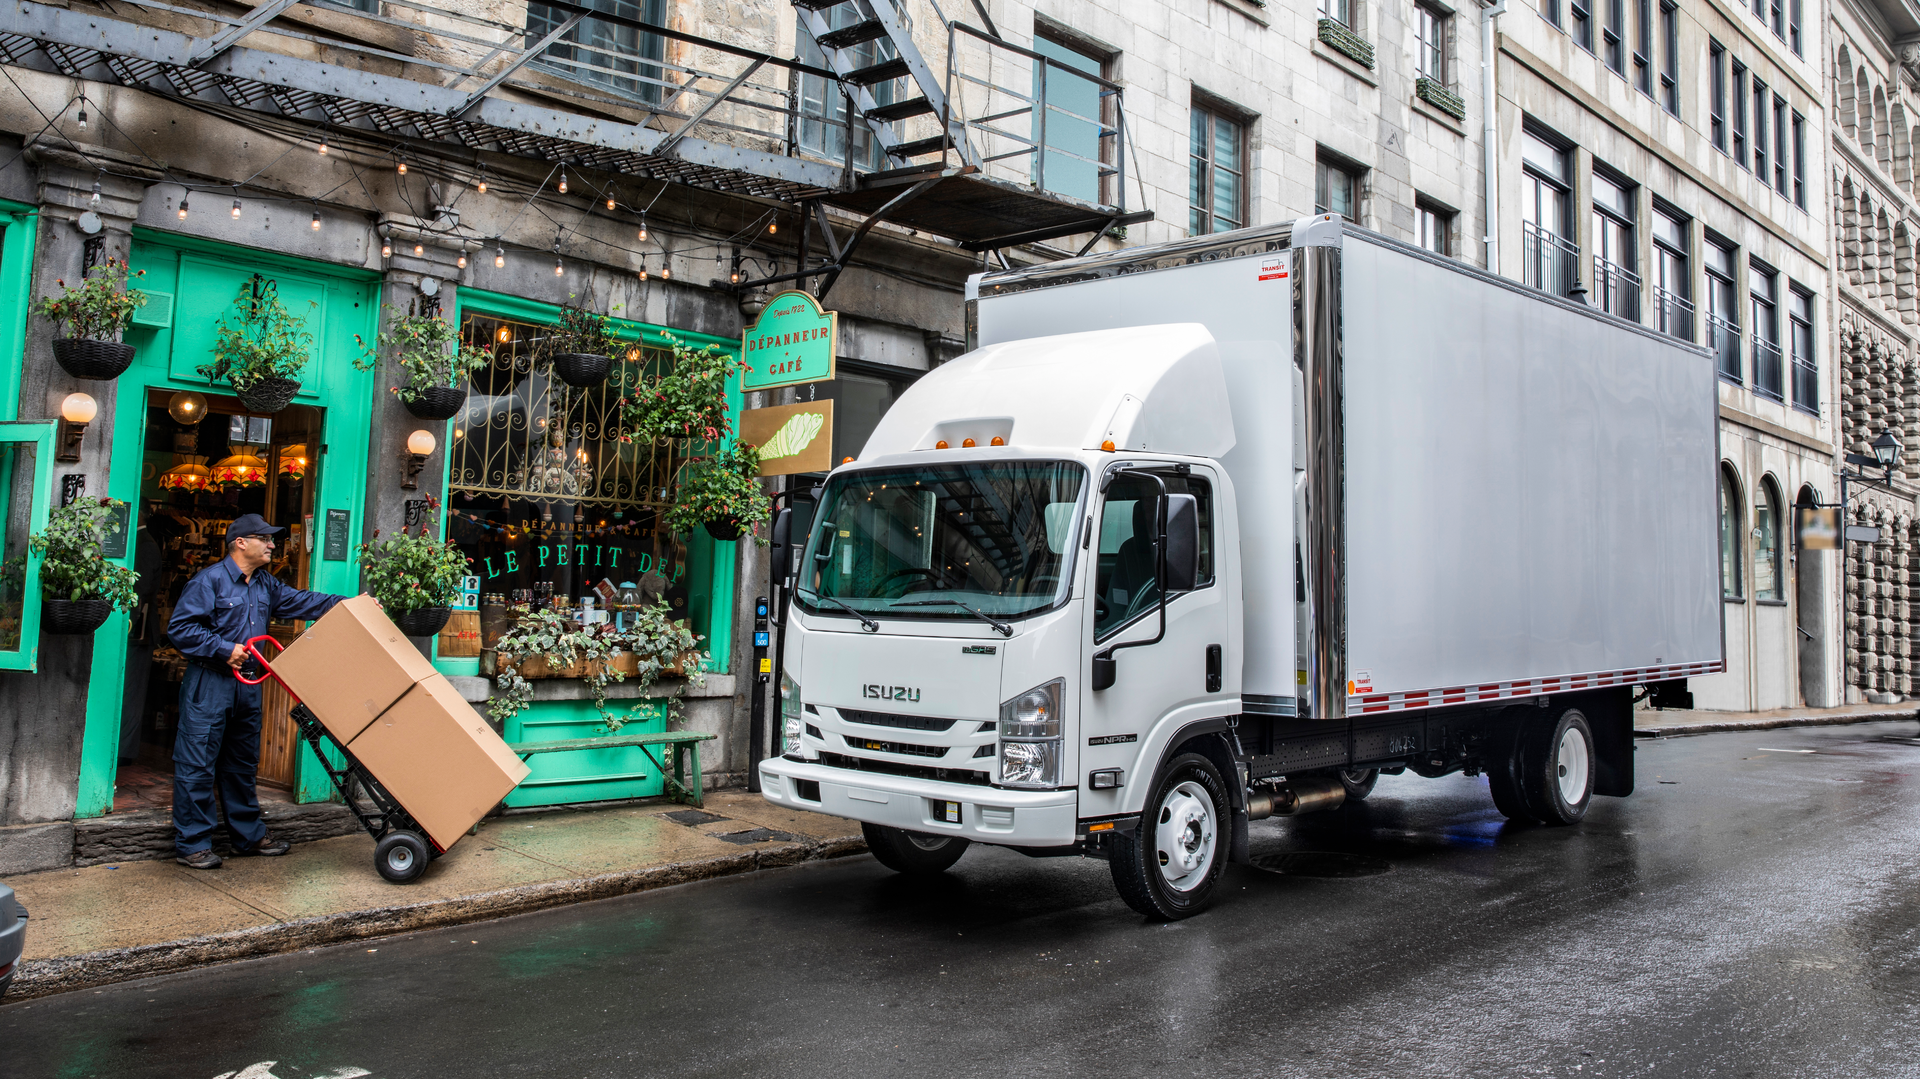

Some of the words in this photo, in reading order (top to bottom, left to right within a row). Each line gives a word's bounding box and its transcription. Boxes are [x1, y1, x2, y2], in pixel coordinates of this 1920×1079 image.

[773, 307, 790, 320] Depuis
[749, 327, 828, 351] DÉPANNEUR
[769, 355, 802, 375] CAFÉ
[522, 518, 601, 533] DÉPANNEUR
[483, 550, 519, 579] LE
[537, 544, 622, 568] PETIT
[638, 552, 683, 583] DEP
[456, 631, 477, 640] ATM
[863, 683, 920, 703] ISUZU
[1103, 735, 1127, 744] NPR
